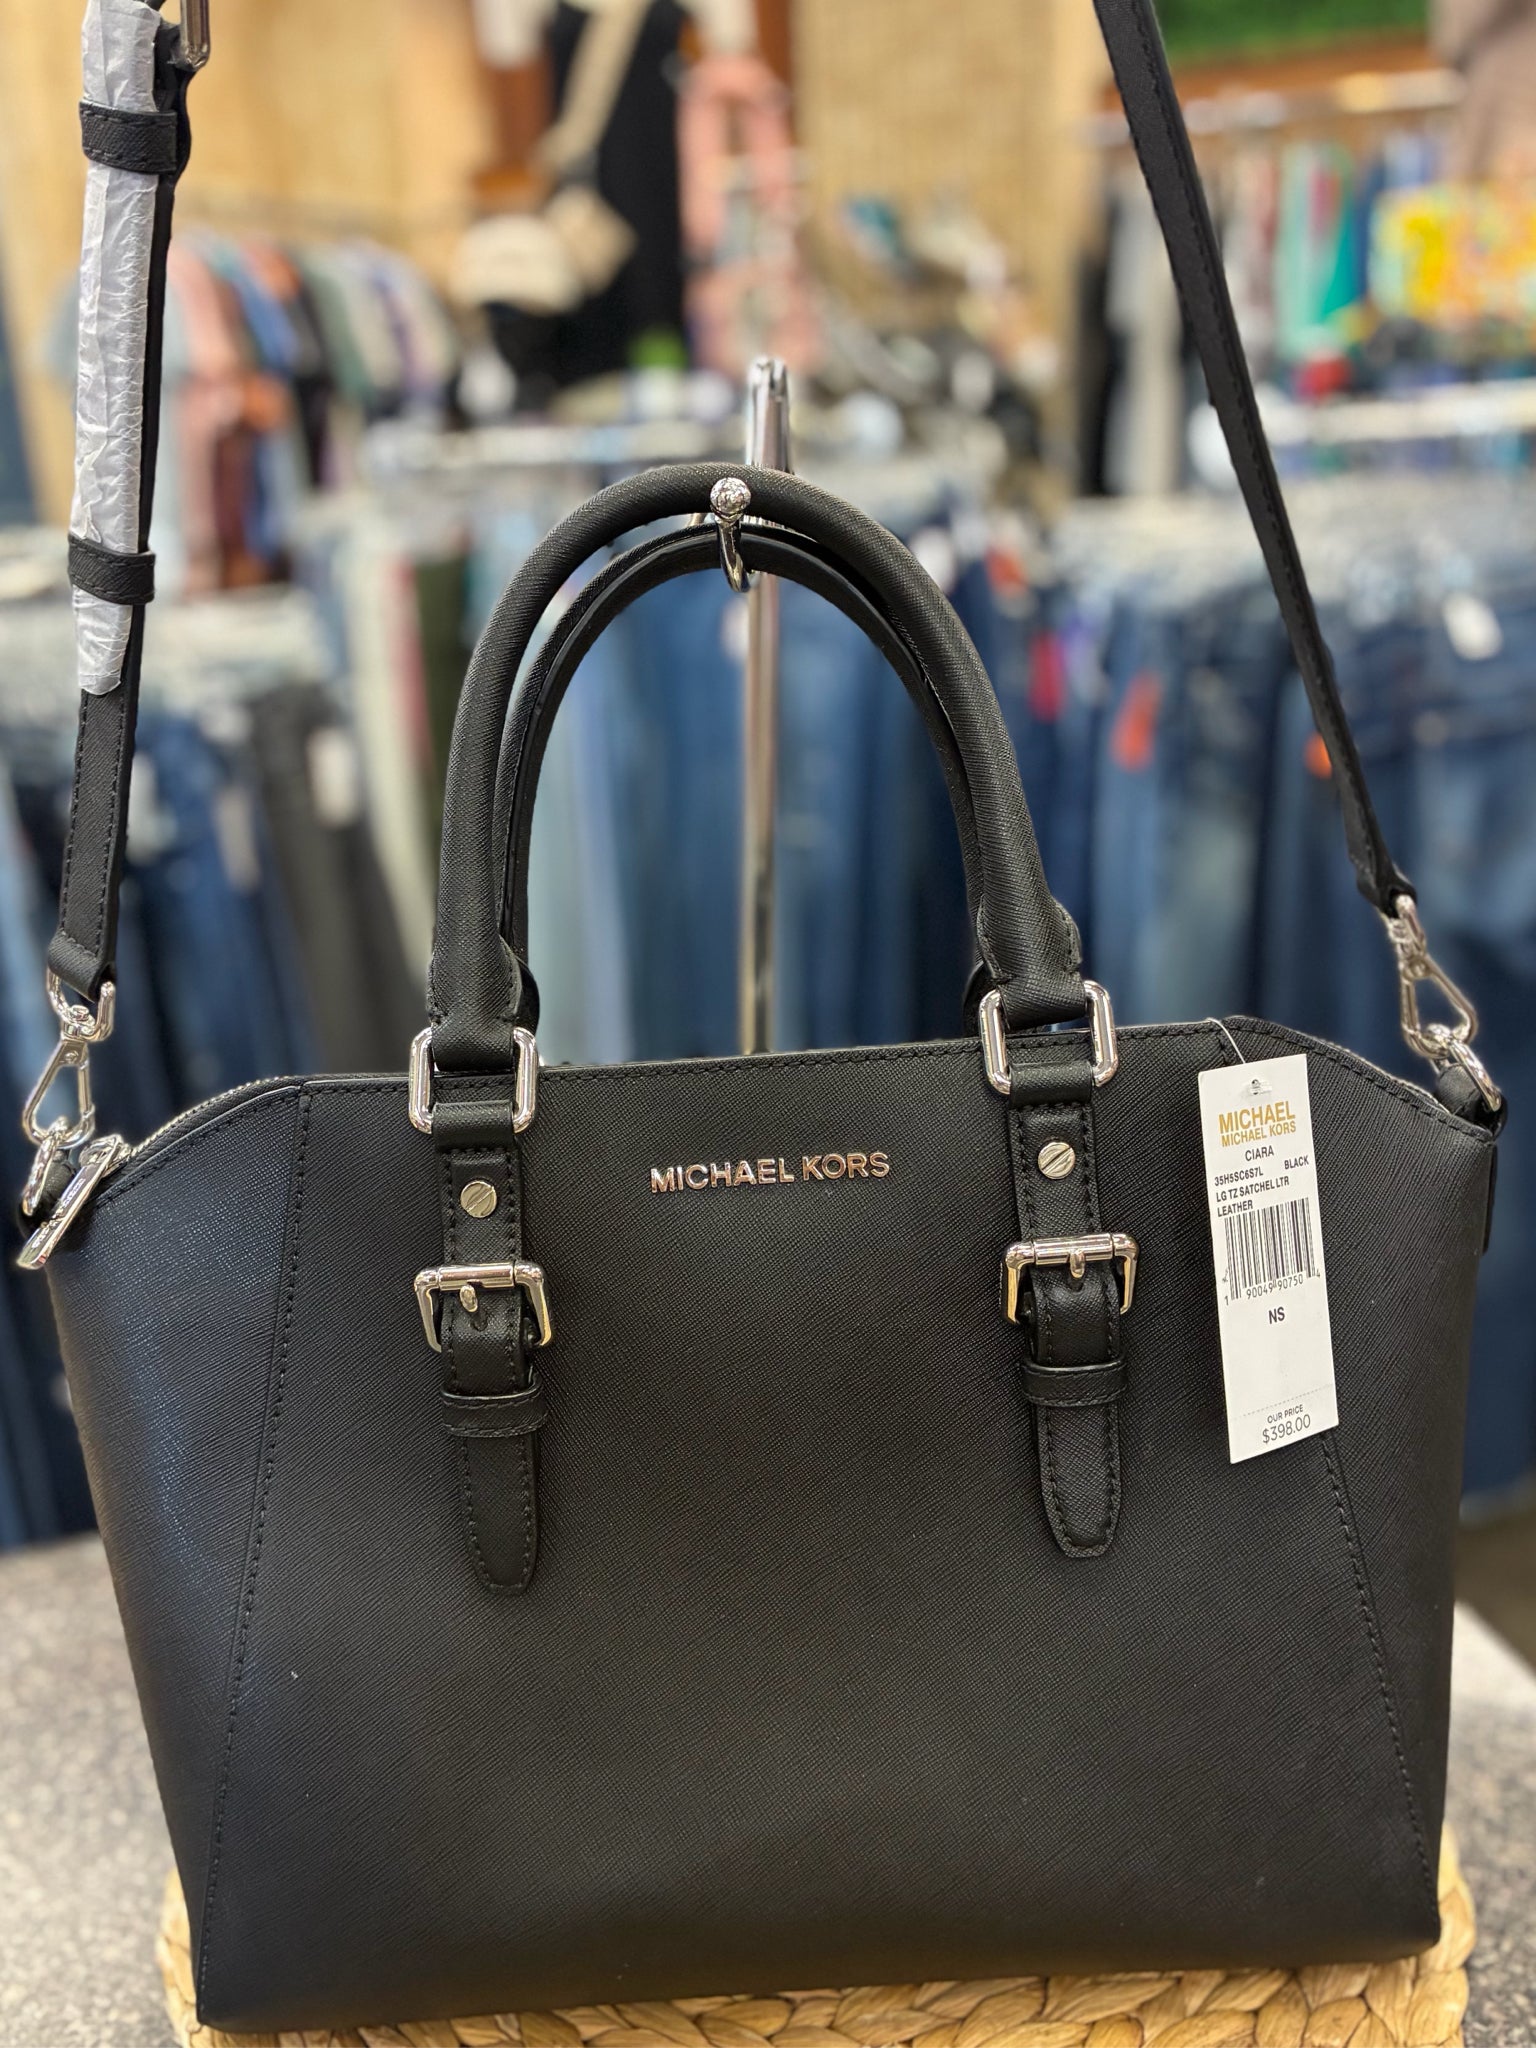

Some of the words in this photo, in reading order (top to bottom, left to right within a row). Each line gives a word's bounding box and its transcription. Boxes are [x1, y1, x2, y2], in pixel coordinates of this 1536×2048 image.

[1219, 1101, 1295, 1134] MICHAEL
[1221, 1127, 1267, 1147] MICHAEL
[1270, 1121, 1296, 1138] KORS
[1245, 1146, 1274, 1161] CIARA
[1284, 1155, 1309, 1170] BLACK
[650, 1158, 795, 1193] MICHAEL
[802, 1152, 890, 1180] KORS
[1216, 1190, 1227, 1202] LG
[1228, 1188, 1238, 1200] TZ
[1239, 1180, 1276, 1197] SATCHEL
[1275, 1176, 1290, 1188] LTR
[1217, 1200, 1254, 1217] LEATHER
[1268, 1306, 1286, 1324] NS
[1267, 1411, 1283, 1424] OUR
[1284, 1404, 1304, 1420] PRICE
[1262, 1413, 1311, 1444] $398.00
